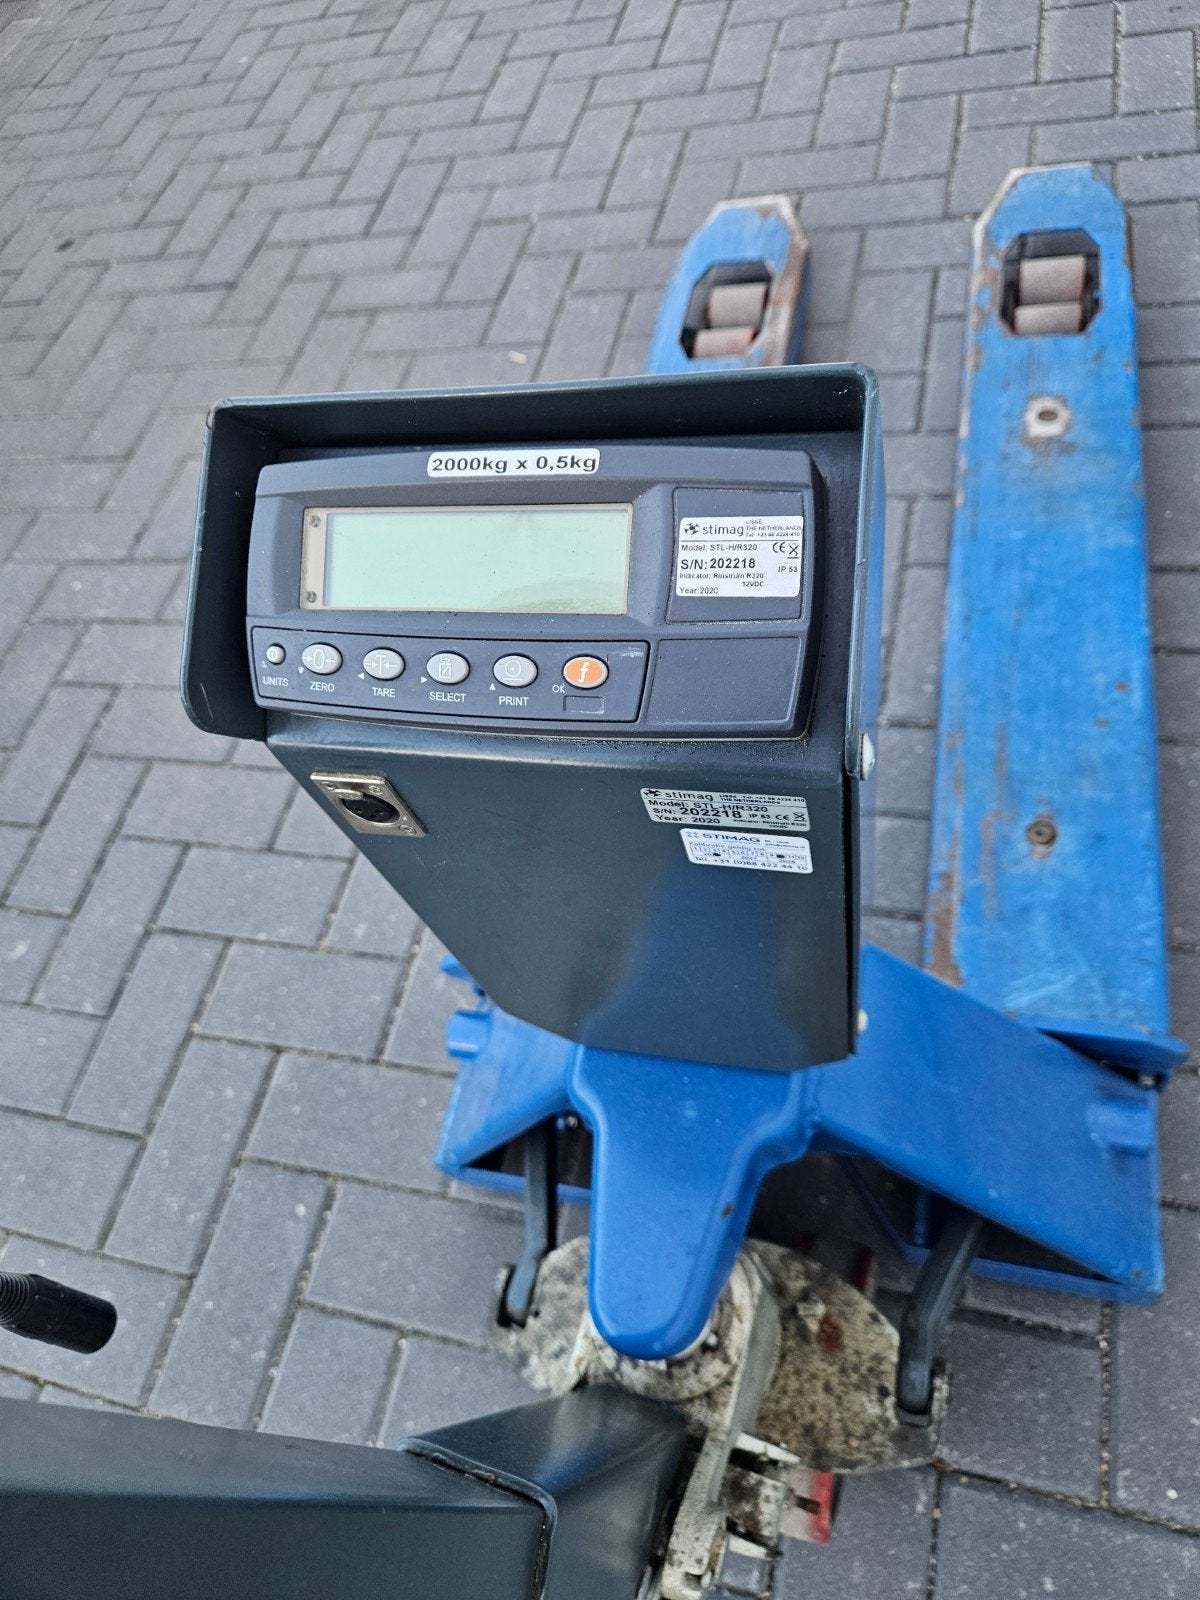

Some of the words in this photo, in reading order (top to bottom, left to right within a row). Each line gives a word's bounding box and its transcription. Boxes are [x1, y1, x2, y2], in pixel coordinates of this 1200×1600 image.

[432, 457, 507, 473] 2000kg
[516, 459, 528, 470] x
[536, 455, 597, 472] 0,5kg
[702, 523, 744, 537] stimag
[710, 543, 758, 551] STL-H/R320
[680, 559, 708, 570] S/N:
[709, 557, 756, 569] 202218
[778, 565, 787, 573] IP
[788, 565, 798, 573] 53
[742, 580, 765, 588] 12VDC
[262, 675, 289, 687] UNITS
[309, 681, 335, 692] ZERO
[372, 686, 396, 698] TARE
[552, 683, 566, 694] OK
[429, 691, 467, 703] SELECT
[498, 695, 530, 707] PRINT
[664, 791, 713, 802] stimag
[648, 799, 690, 808] Model:
[693, 801, 769, 813] STL-H/R320
[655, 814, 687, 822] Year:
[679, 807, 742, 819] 202218
[703, 833, 760, 843] STIMAG
